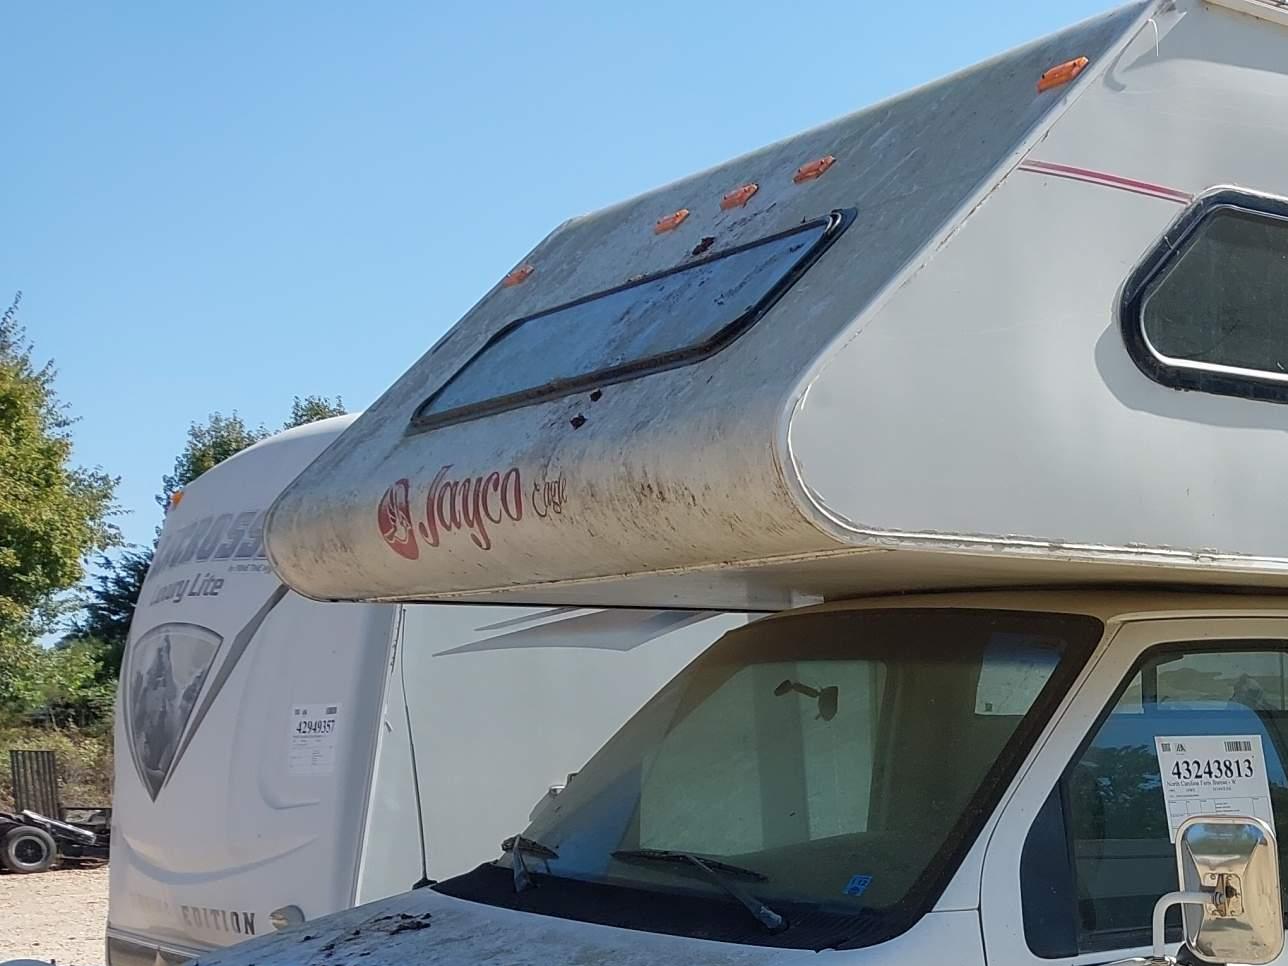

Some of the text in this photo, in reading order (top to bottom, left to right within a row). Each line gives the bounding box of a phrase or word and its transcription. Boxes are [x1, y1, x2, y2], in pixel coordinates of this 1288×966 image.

[419, 464, 522, 550] Jayco
[188, 572, 224, 596] Lite
[296, 720, 335, 733] 42949357
[1171, 759, 1253, 779] 43243813
[181, 905, 256, 935] EDITION
